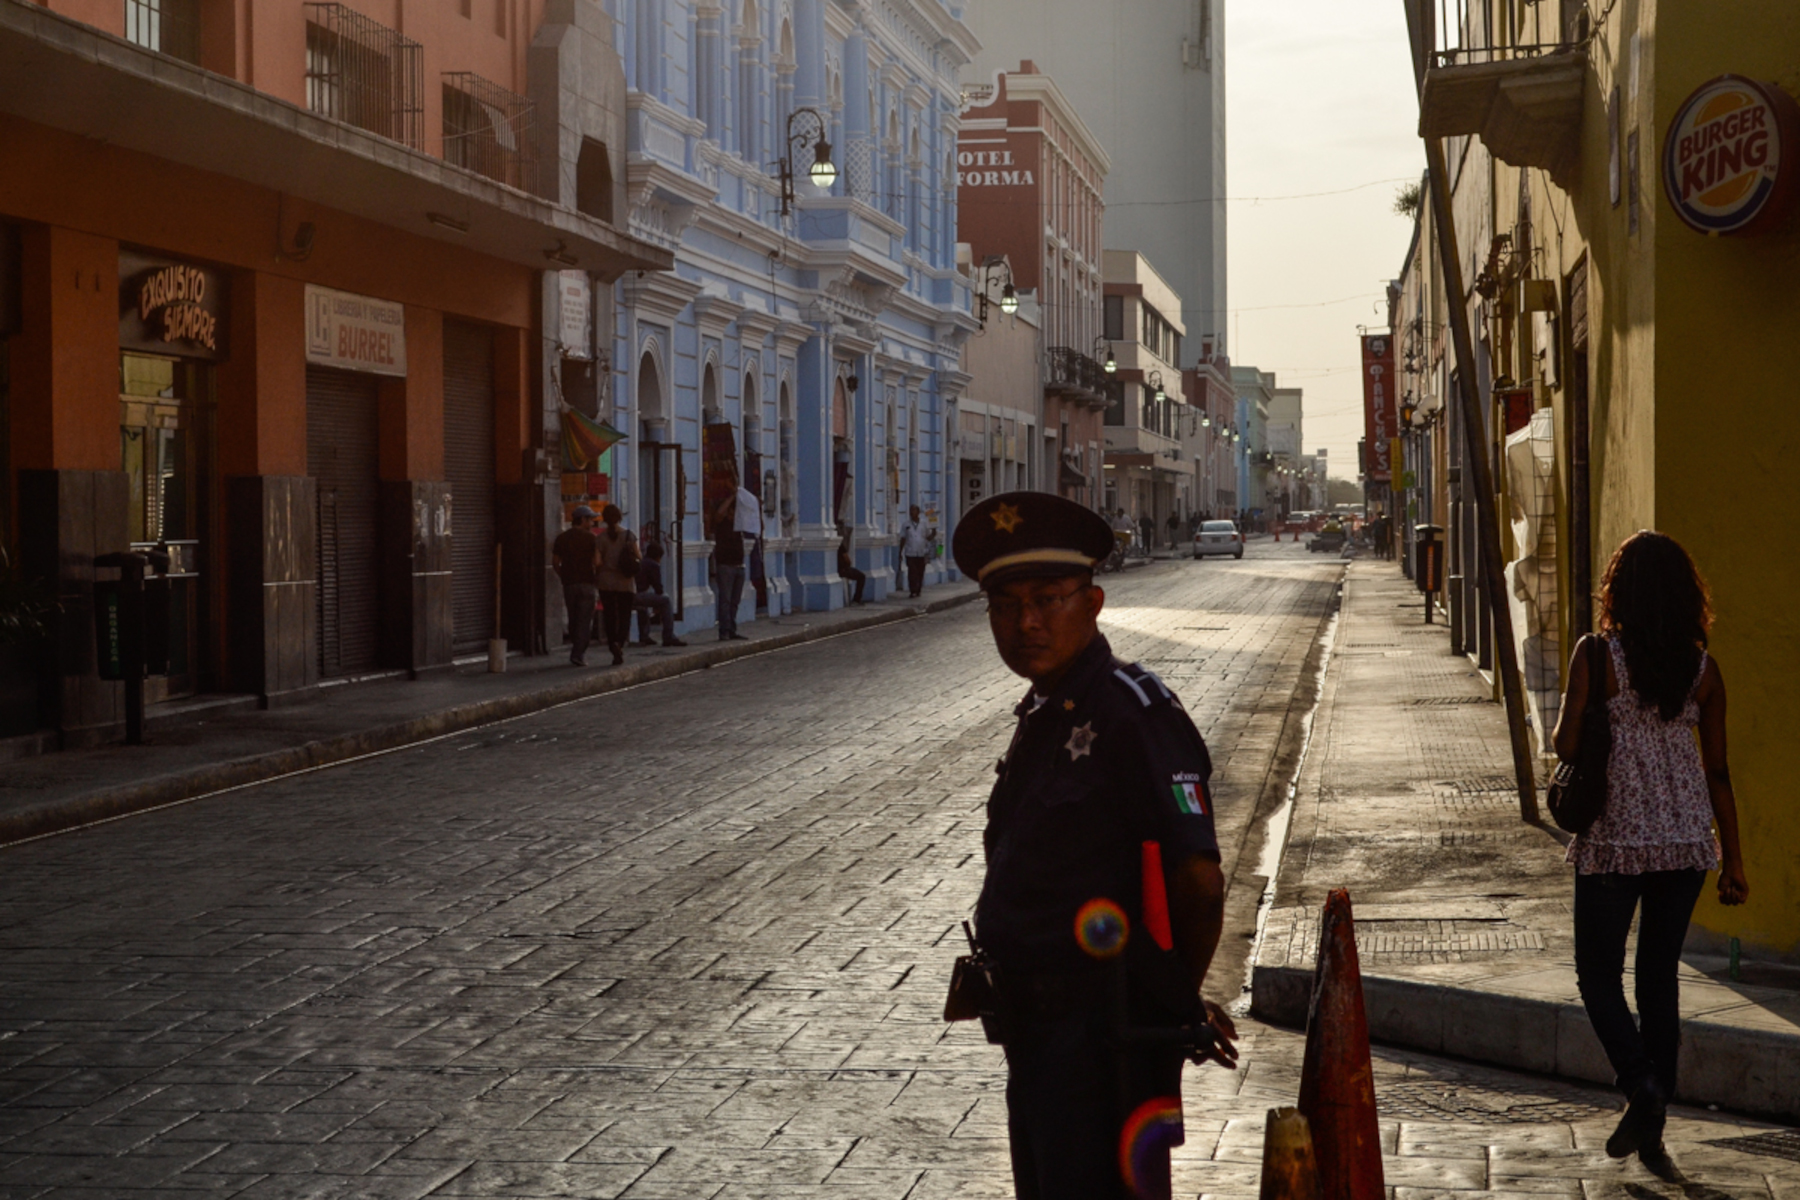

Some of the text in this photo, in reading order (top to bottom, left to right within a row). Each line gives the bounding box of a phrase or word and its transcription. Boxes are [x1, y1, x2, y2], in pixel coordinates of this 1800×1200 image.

[1680, 105, 1765, 165] BURGER
[1681, 130, 1768, 202] KING
[141, 264, 205, 321] EXQUISITO
[1369, 364, 1388, 470] PANCHO'S
